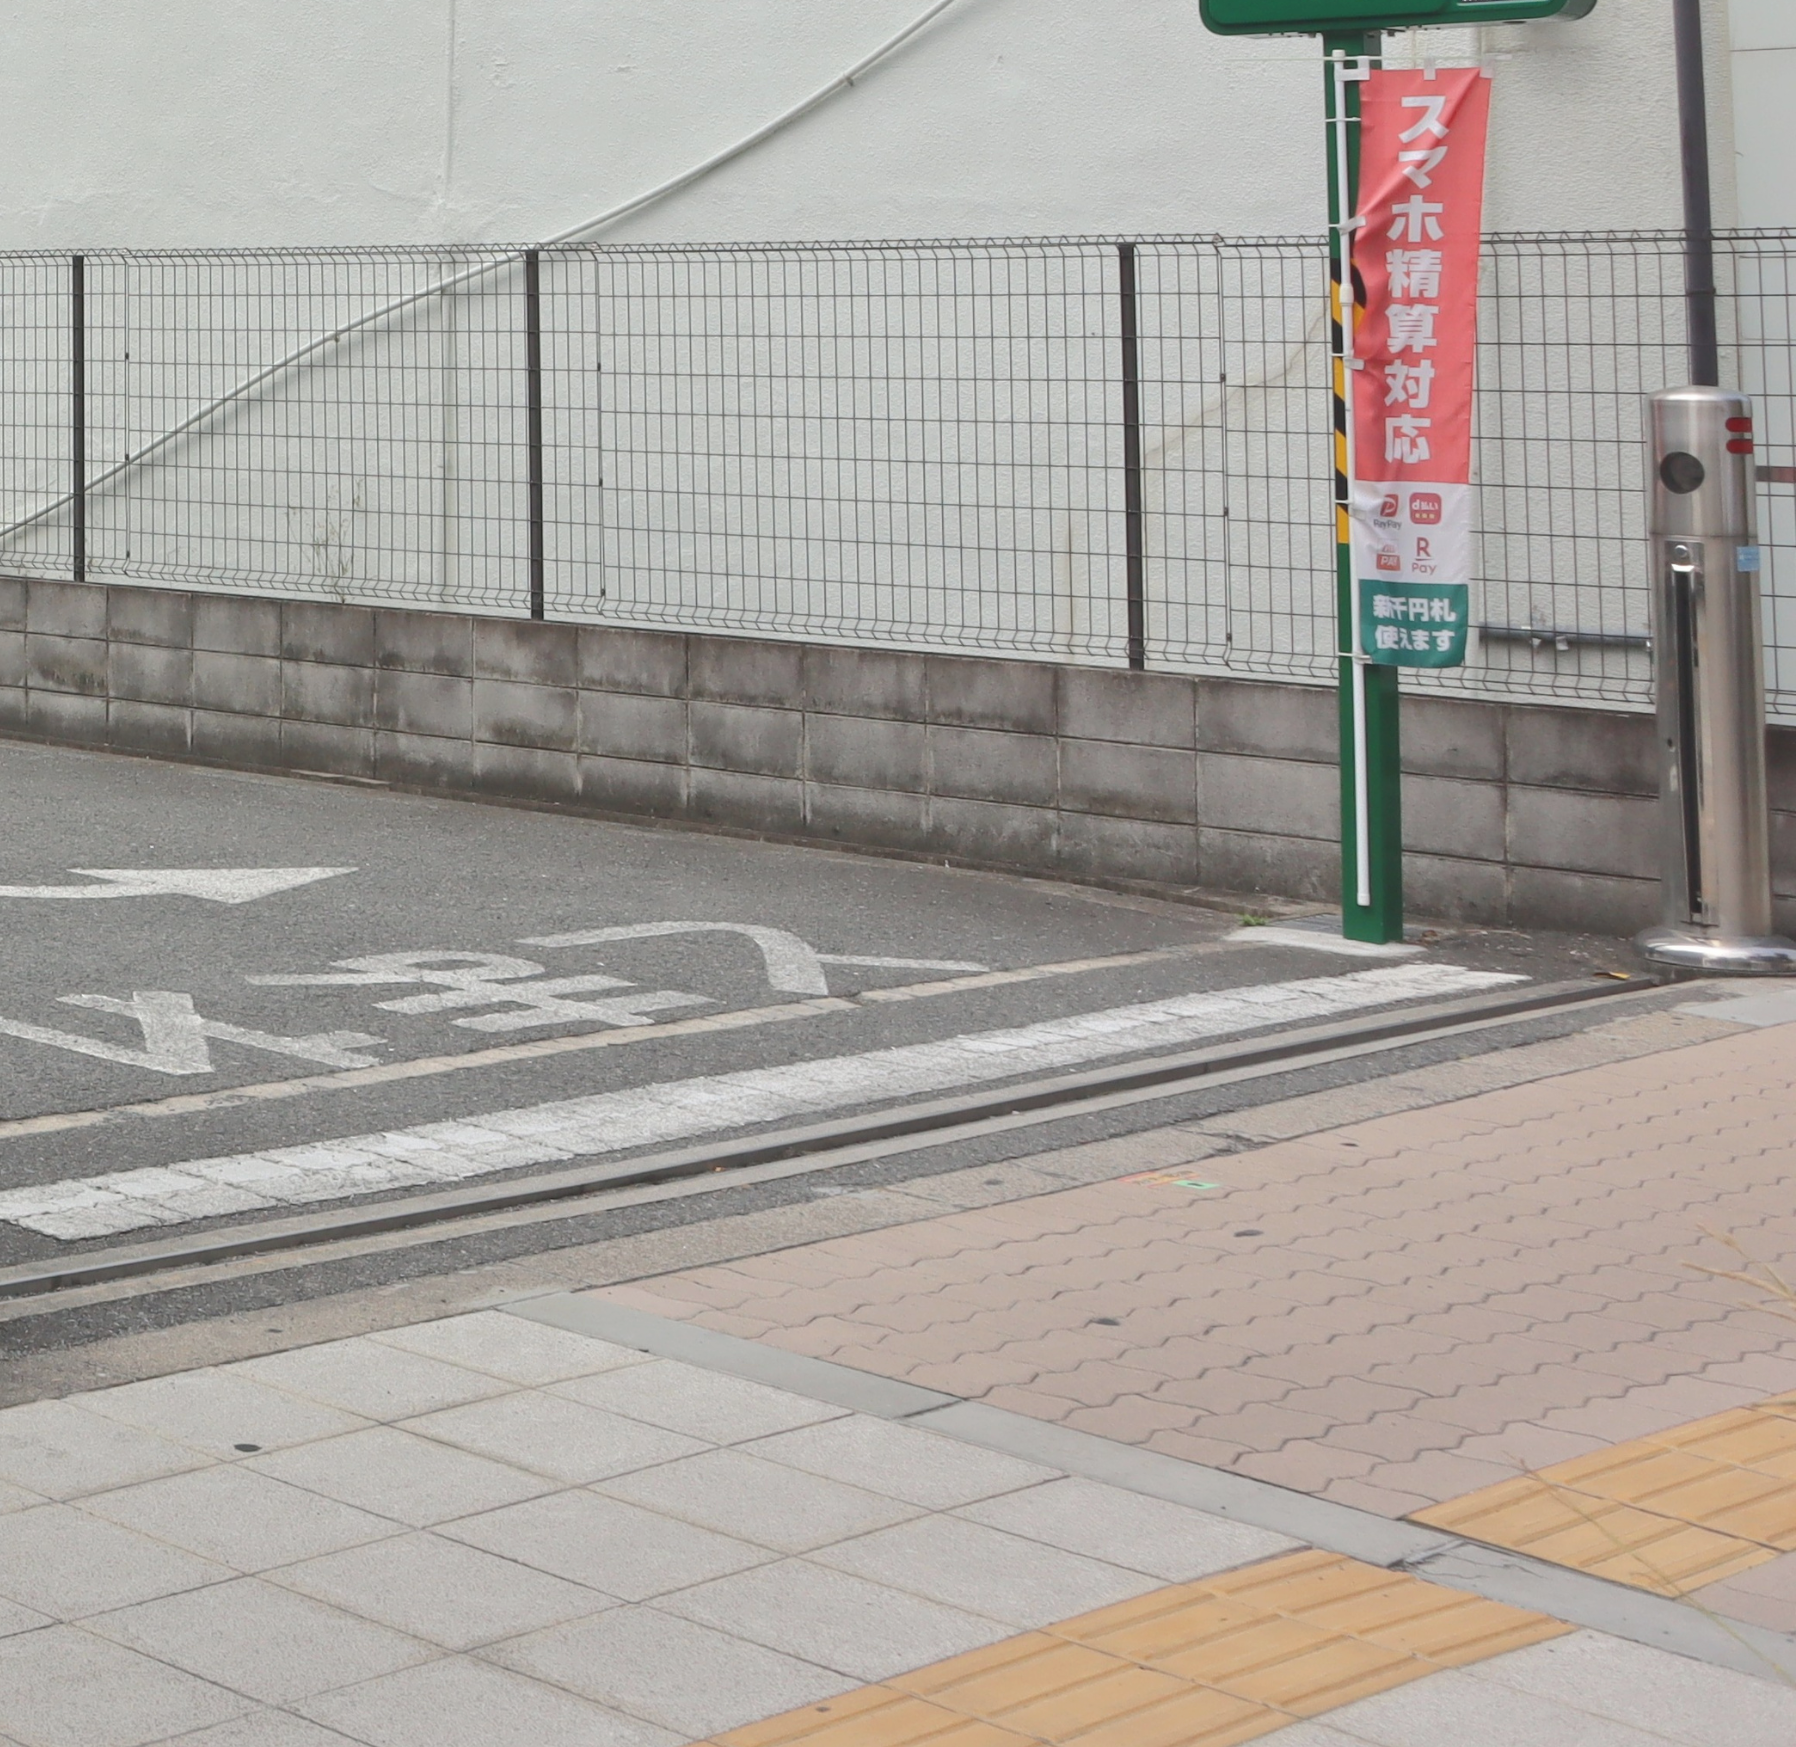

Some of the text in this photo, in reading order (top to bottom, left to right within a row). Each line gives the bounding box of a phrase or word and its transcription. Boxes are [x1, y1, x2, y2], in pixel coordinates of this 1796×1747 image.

[1384, 95, 1450, 464] スマホ精算対応
[1373, 519, 1402, 530] PayPay
[1412, 562, 1437, 575] Pay
[1375, 625, 1455, 652] 使えます
